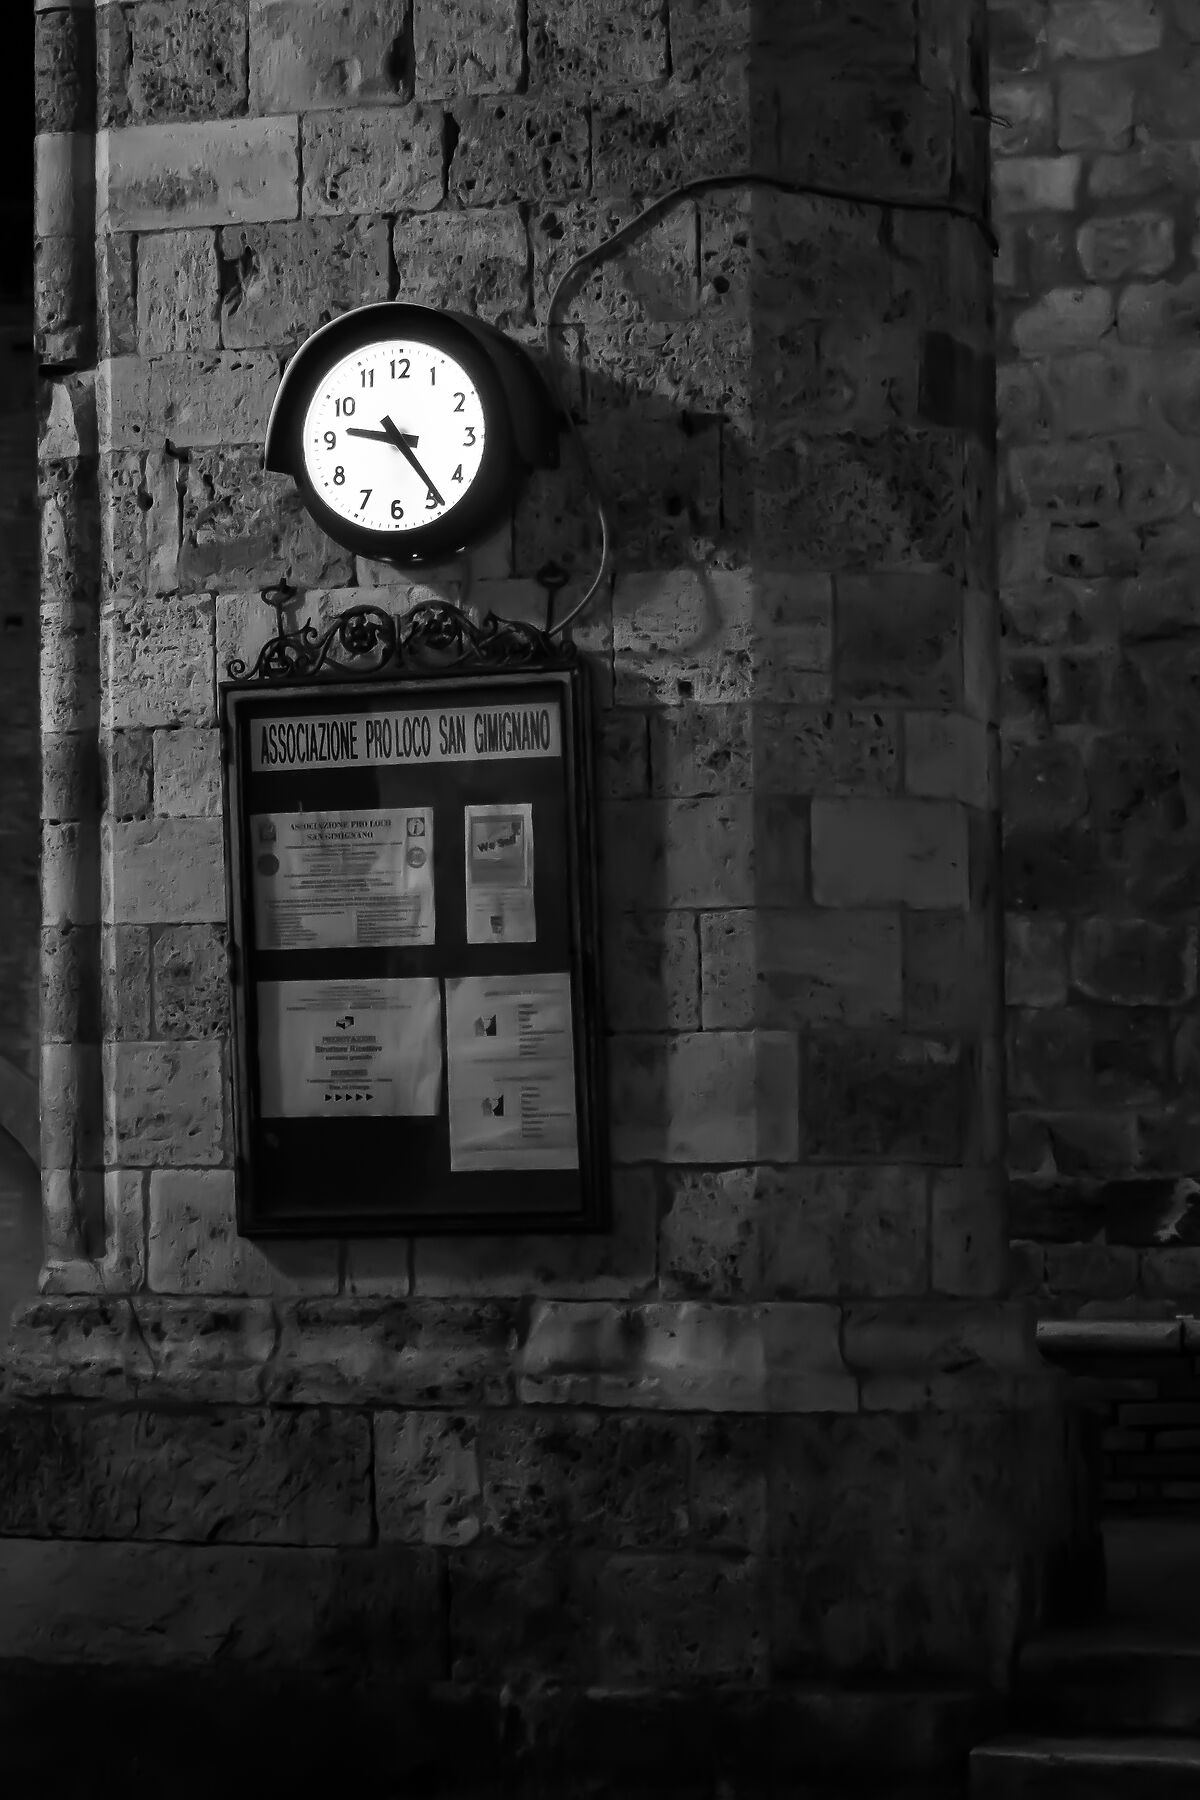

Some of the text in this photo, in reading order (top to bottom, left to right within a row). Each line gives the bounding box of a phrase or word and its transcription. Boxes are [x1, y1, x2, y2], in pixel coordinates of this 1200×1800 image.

[360, 367, 374, 389] 11
[390, 358, 411, 380] 12
[430, 366, 436, 386] 1
[335, 396, 356, 417] 10
[453, 392, 466, 413] 2
[323, 430, 337, 450] 9
[462, 427, 476, 447] 3
[333, 465, 346, 486] 8
[451, 463, 464, 484] 4
[359, 489, 373, 510] 7
[390, 499, 404, 520] 6
[261, 721, 359, 764] ASSOCIAZIONE
[439, 714, 466, 755] SAN
[474, 709, 551, 754] GIMIGNANO
